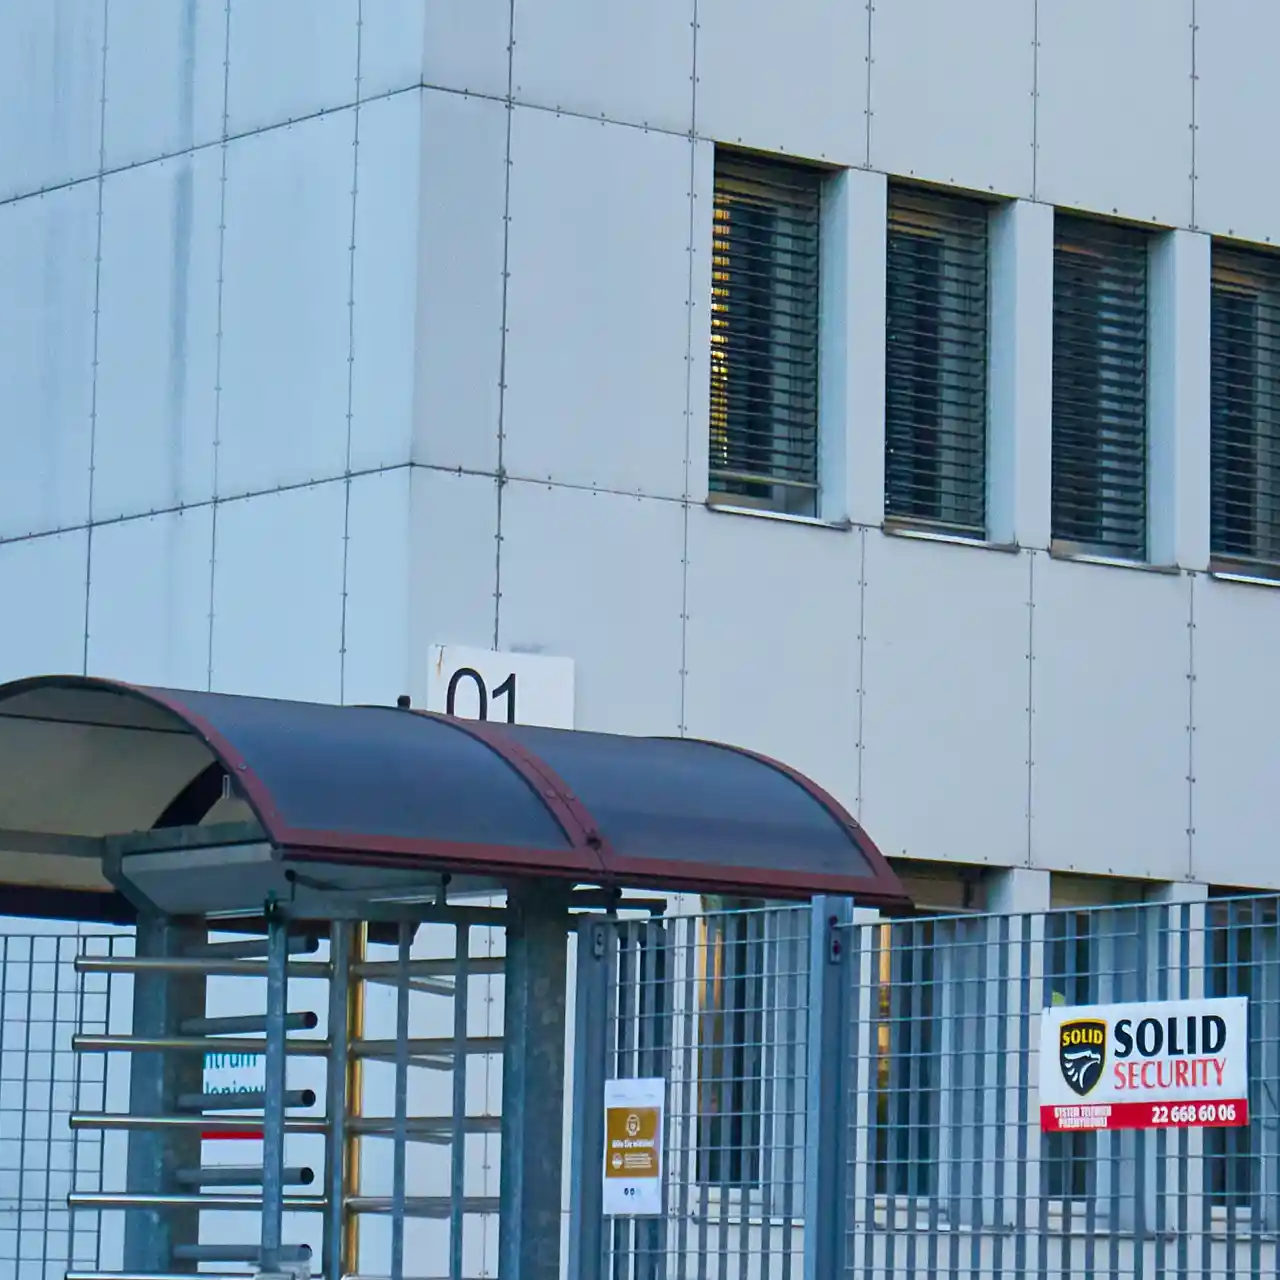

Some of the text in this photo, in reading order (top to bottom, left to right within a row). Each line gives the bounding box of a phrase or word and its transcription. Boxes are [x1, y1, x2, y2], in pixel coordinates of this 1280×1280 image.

[447, 667, 516, 724] 01
[1062, 1028, 1103, 1046] SOLID
[1114, 1015, 1227, 1058] SOLID
[1114, 1058, 1226, 1090] SECURITY
[1151, 1104, 1236, 1124] 22 668 60 06
